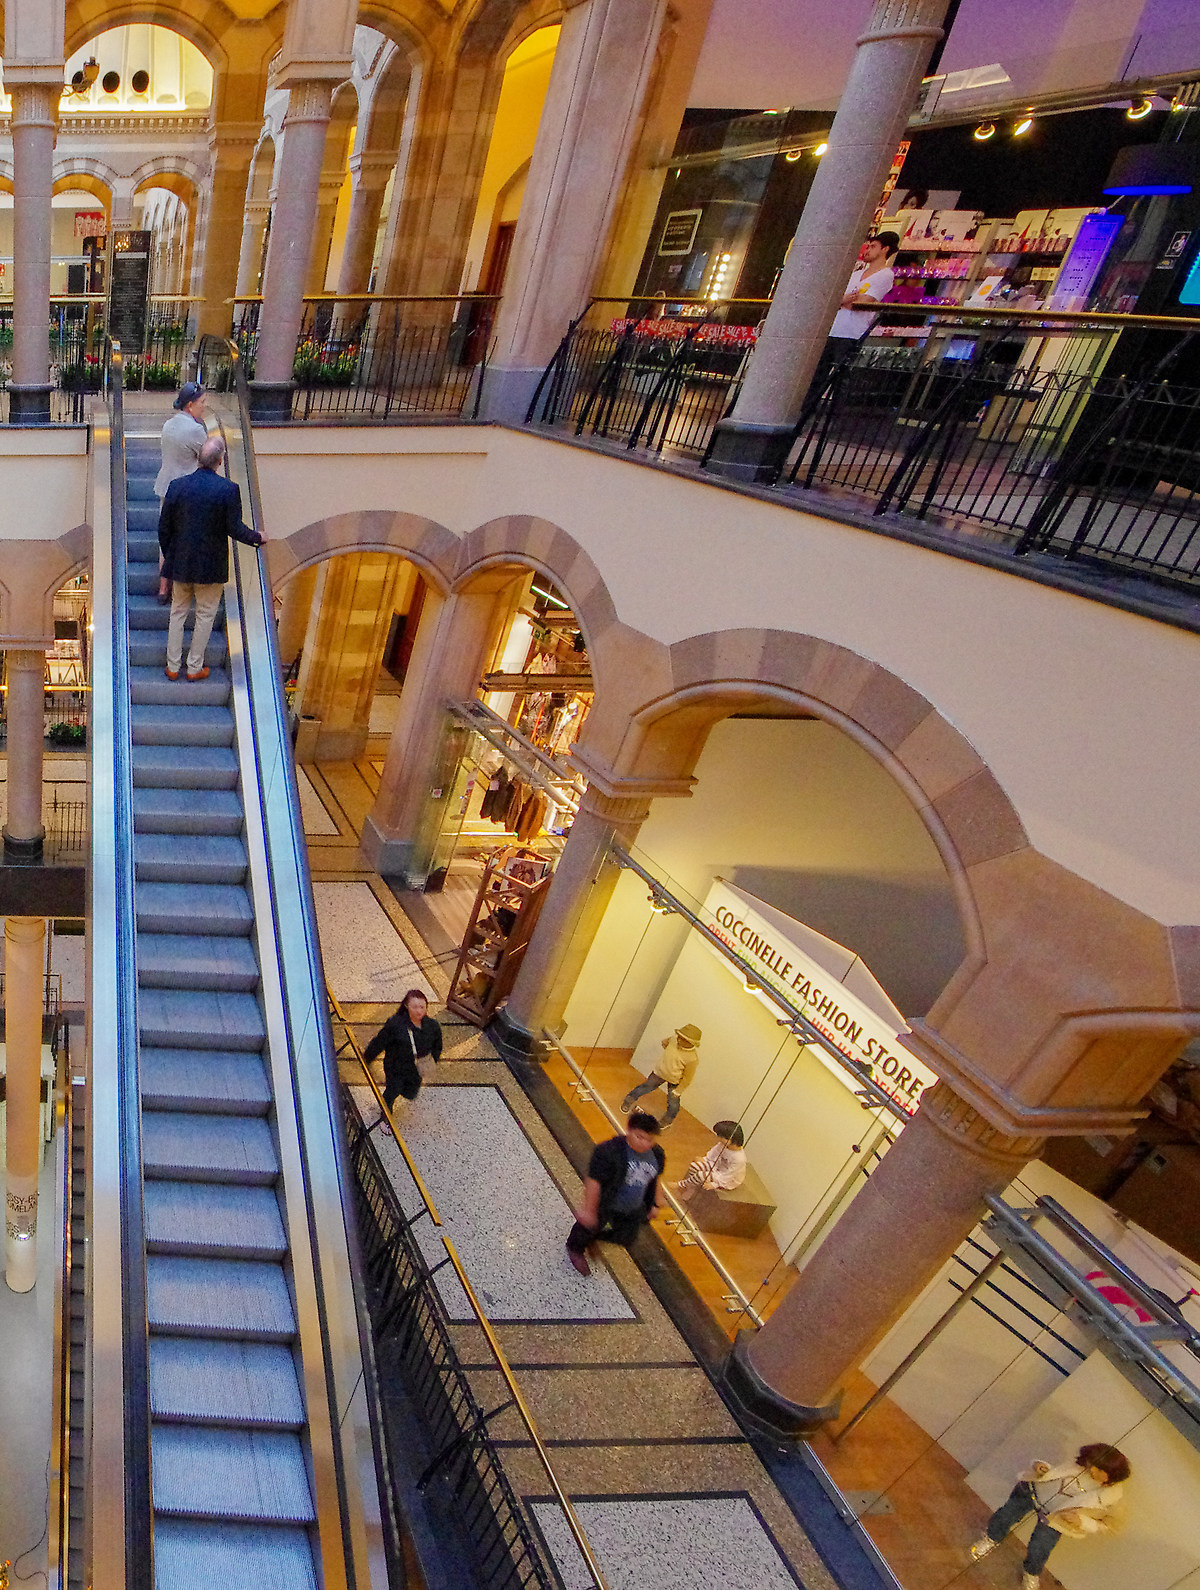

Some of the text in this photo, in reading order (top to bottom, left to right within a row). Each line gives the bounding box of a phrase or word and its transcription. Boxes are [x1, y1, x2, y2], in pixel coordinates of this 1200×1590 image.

[715, 906, 924, 1104] COCCINELLE FASHION STORE
